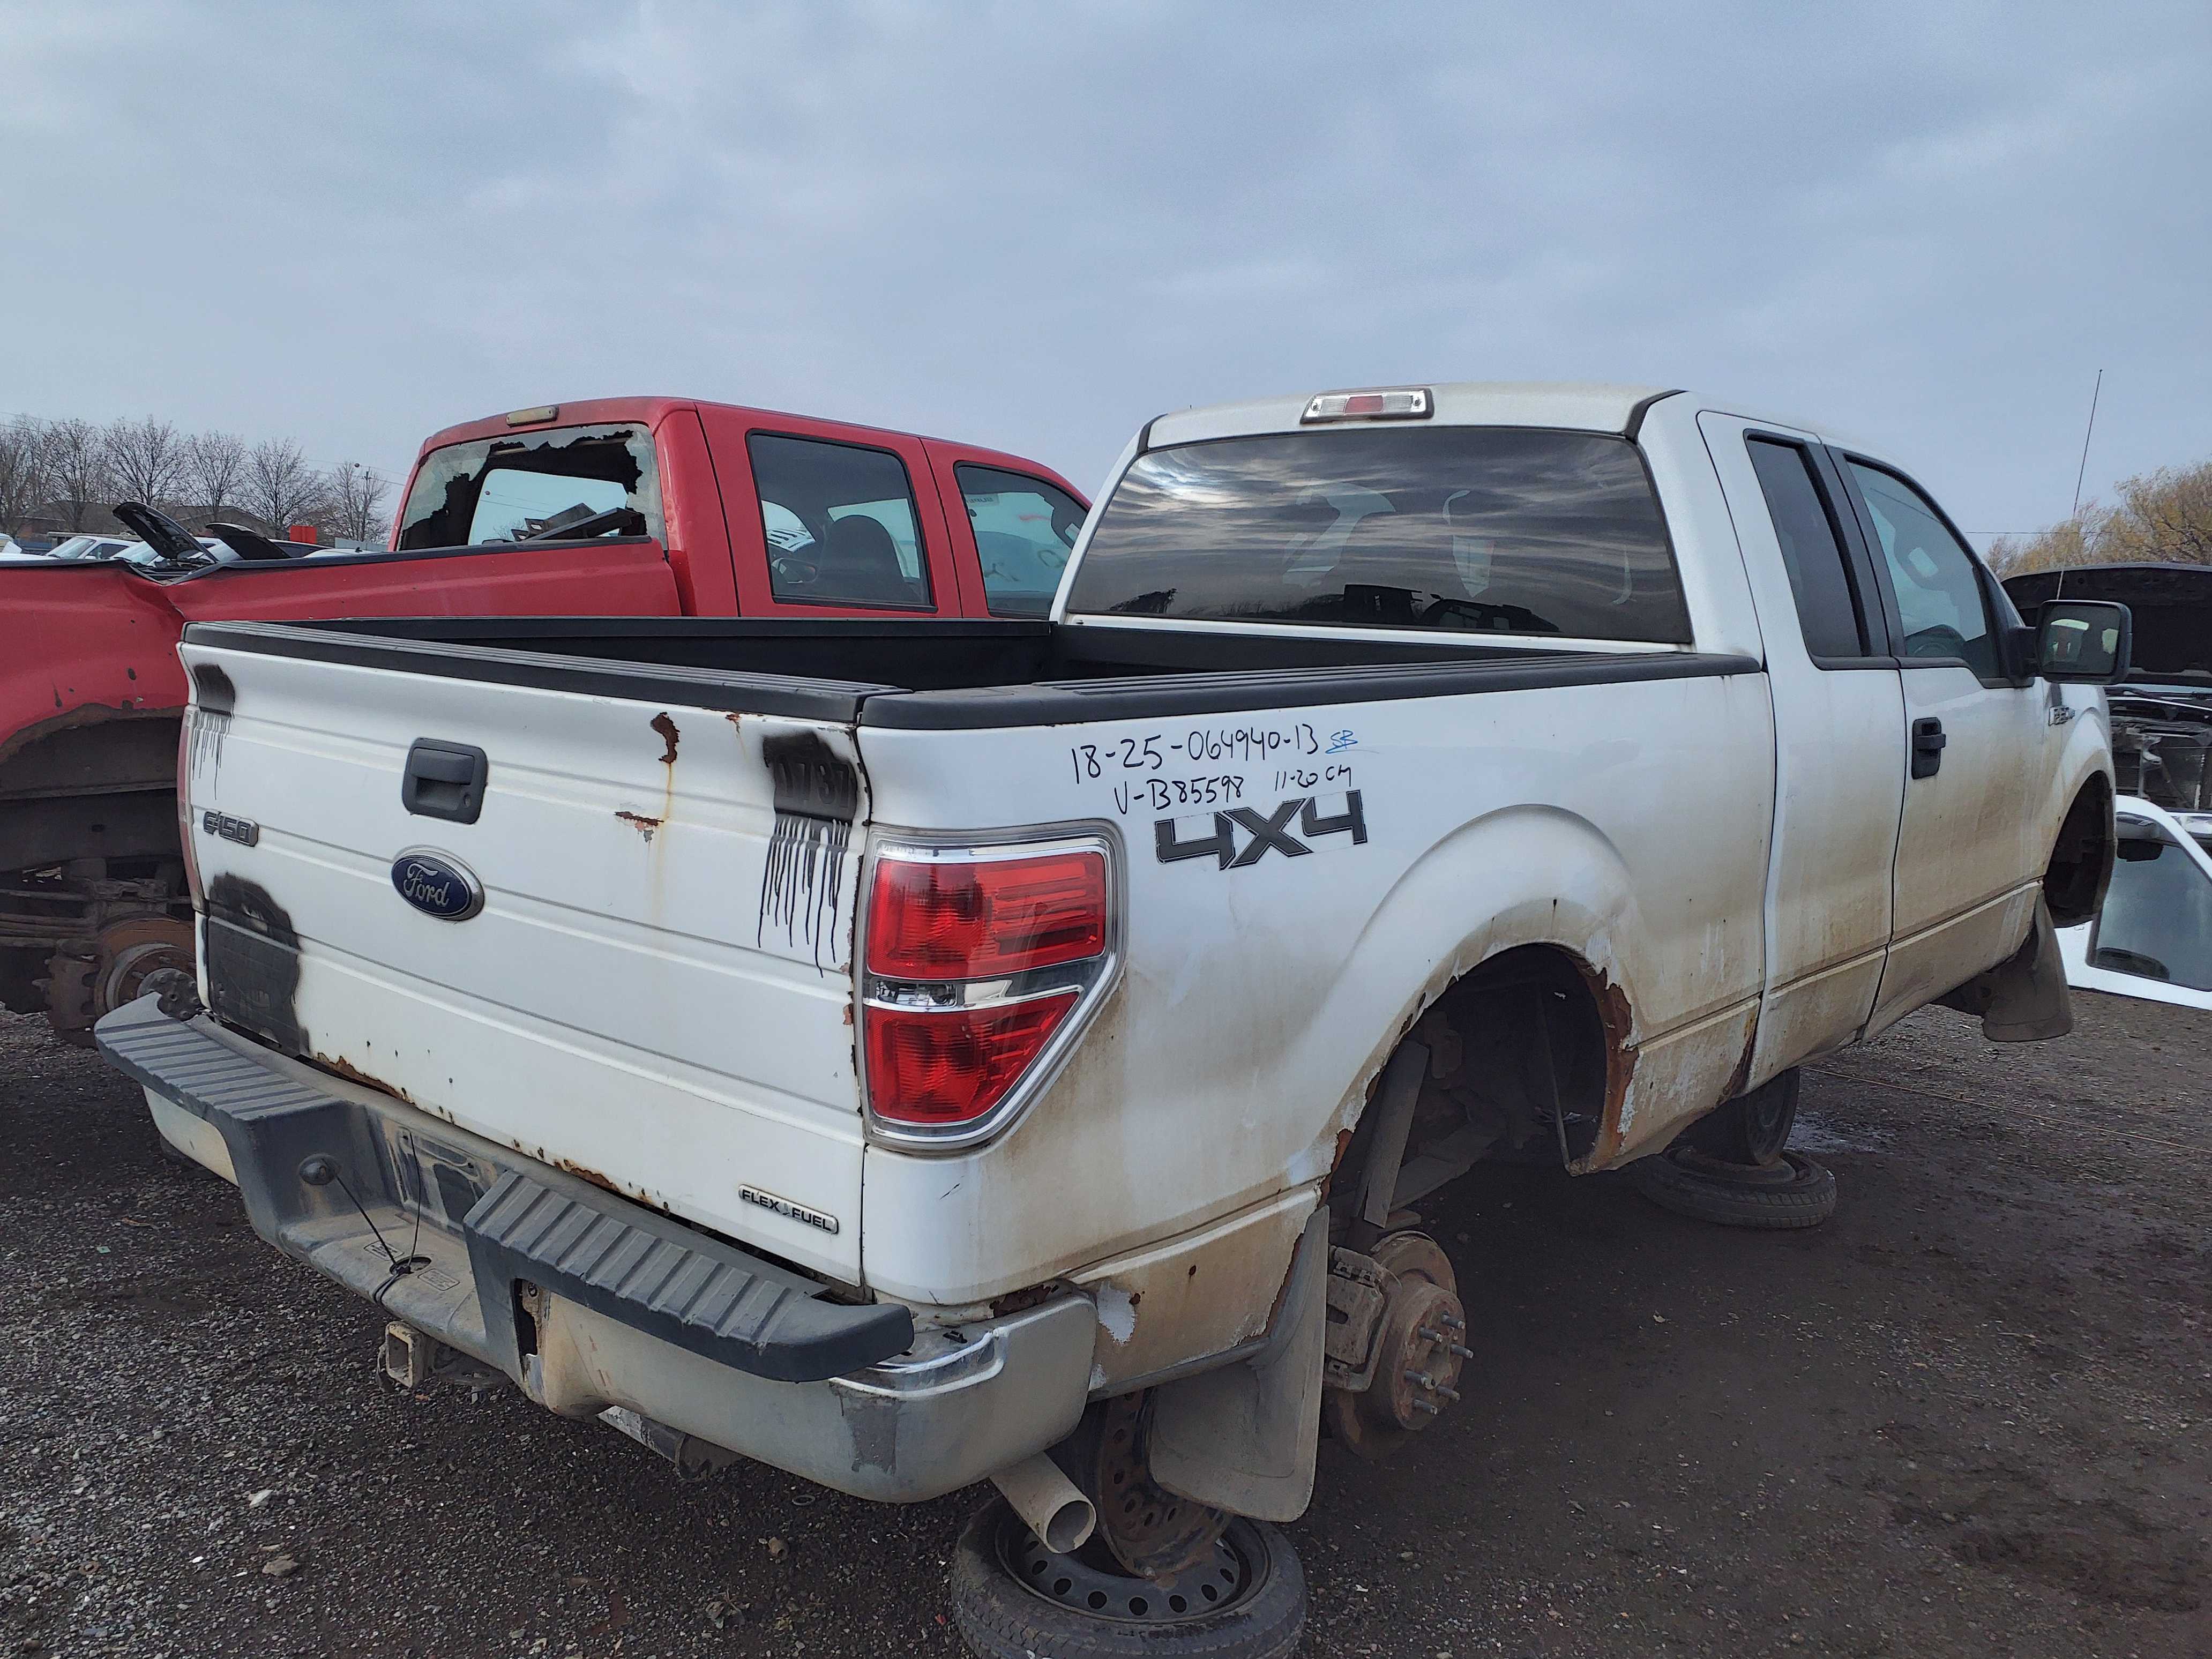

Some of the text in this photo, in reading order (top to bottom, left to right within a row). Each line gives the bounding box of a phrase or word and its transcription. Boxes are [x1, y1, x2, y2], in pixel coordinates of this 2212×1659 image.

[1072, 723, 1318, 784] 18-25-064940-13
[404, 862, 450, 908] Ford
[742, 1189, 832, 1232] FLEX FUEL
